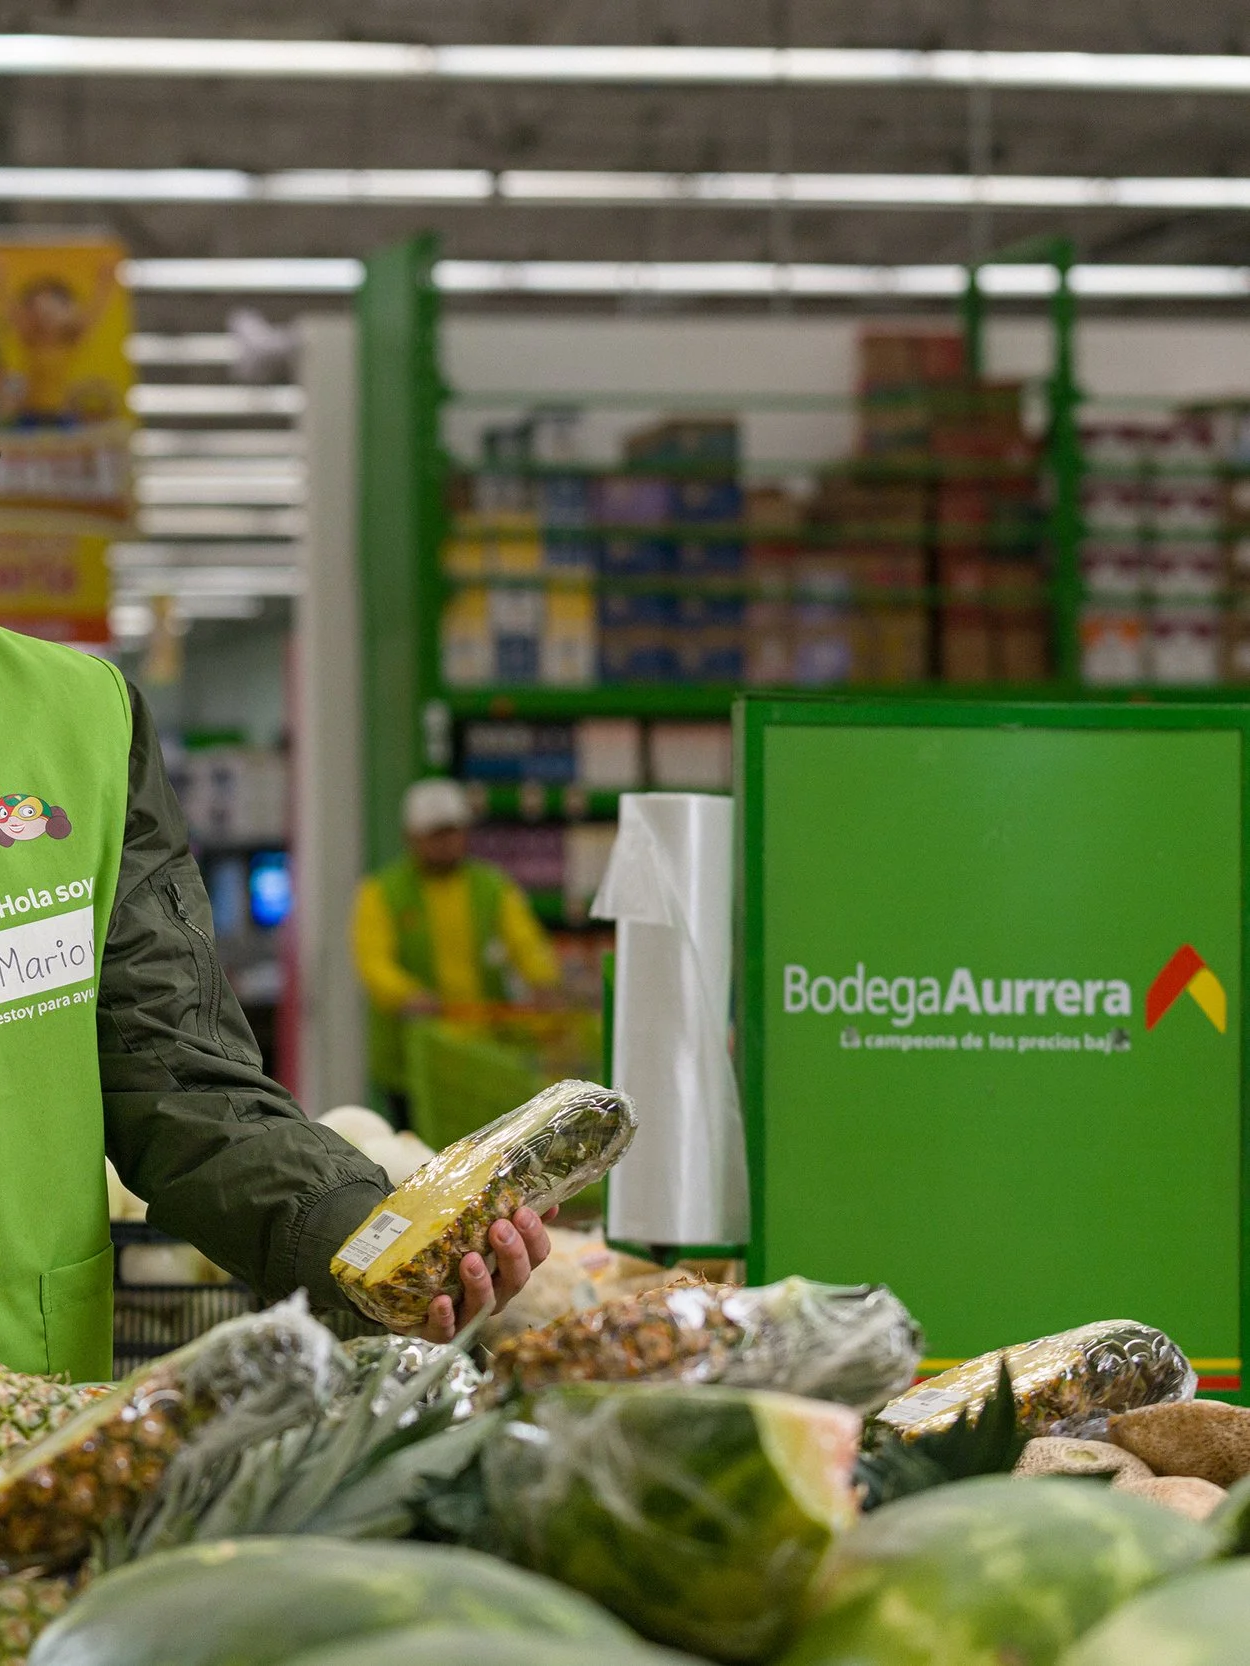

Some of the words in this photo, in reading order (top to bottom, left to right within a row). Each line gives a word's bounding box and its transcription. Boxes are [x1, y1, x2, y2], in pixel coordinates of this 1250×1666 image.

[55, 876, 94, 903] soy
[37, 994, 71, 1017] para
[864, 1033, 959, 1053] campeona
[961, 1031, 984, 1049] de
[988, 1031, 1015, 1050] los
[1018, 1032, 1081, 1054] precios
[1083, 1030, 1132, 1056] baj
